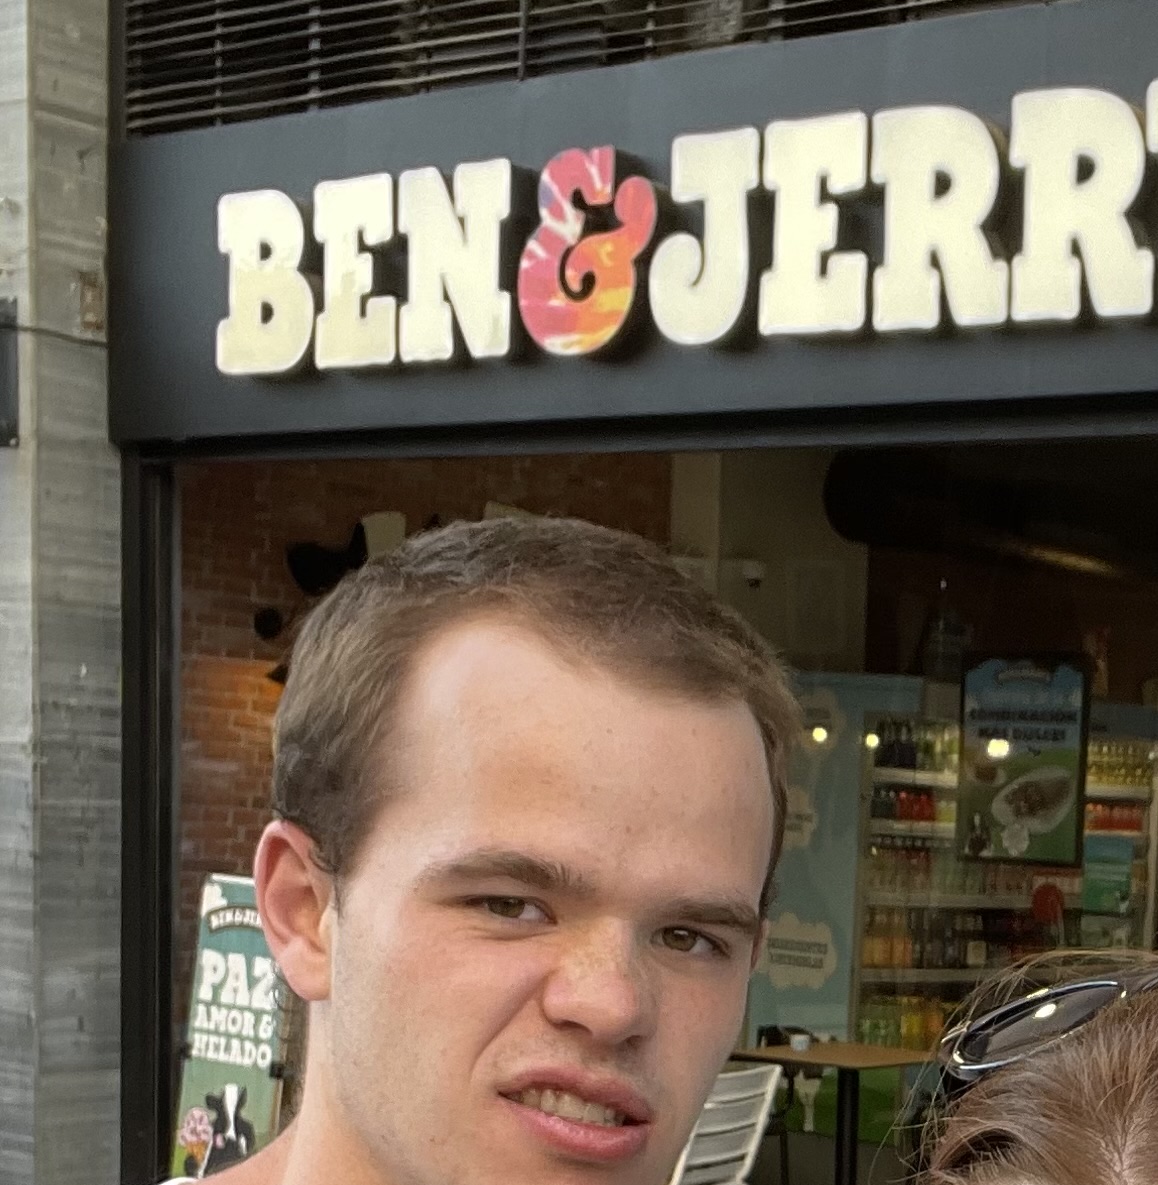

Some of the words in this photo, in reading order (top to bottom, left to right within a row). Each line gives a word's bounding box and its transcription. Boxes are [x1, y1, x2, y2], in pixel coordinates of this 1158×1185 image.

[216, 158, 511, 375] BEN
[517, 145, 657, 356] &
[198, 947, 279, 1010] PAZ
[194, 1004, 256, 1038] AMOR
[259, 1013, 276, 1040] &
[191, 1032, 272, 1068] HELADO
